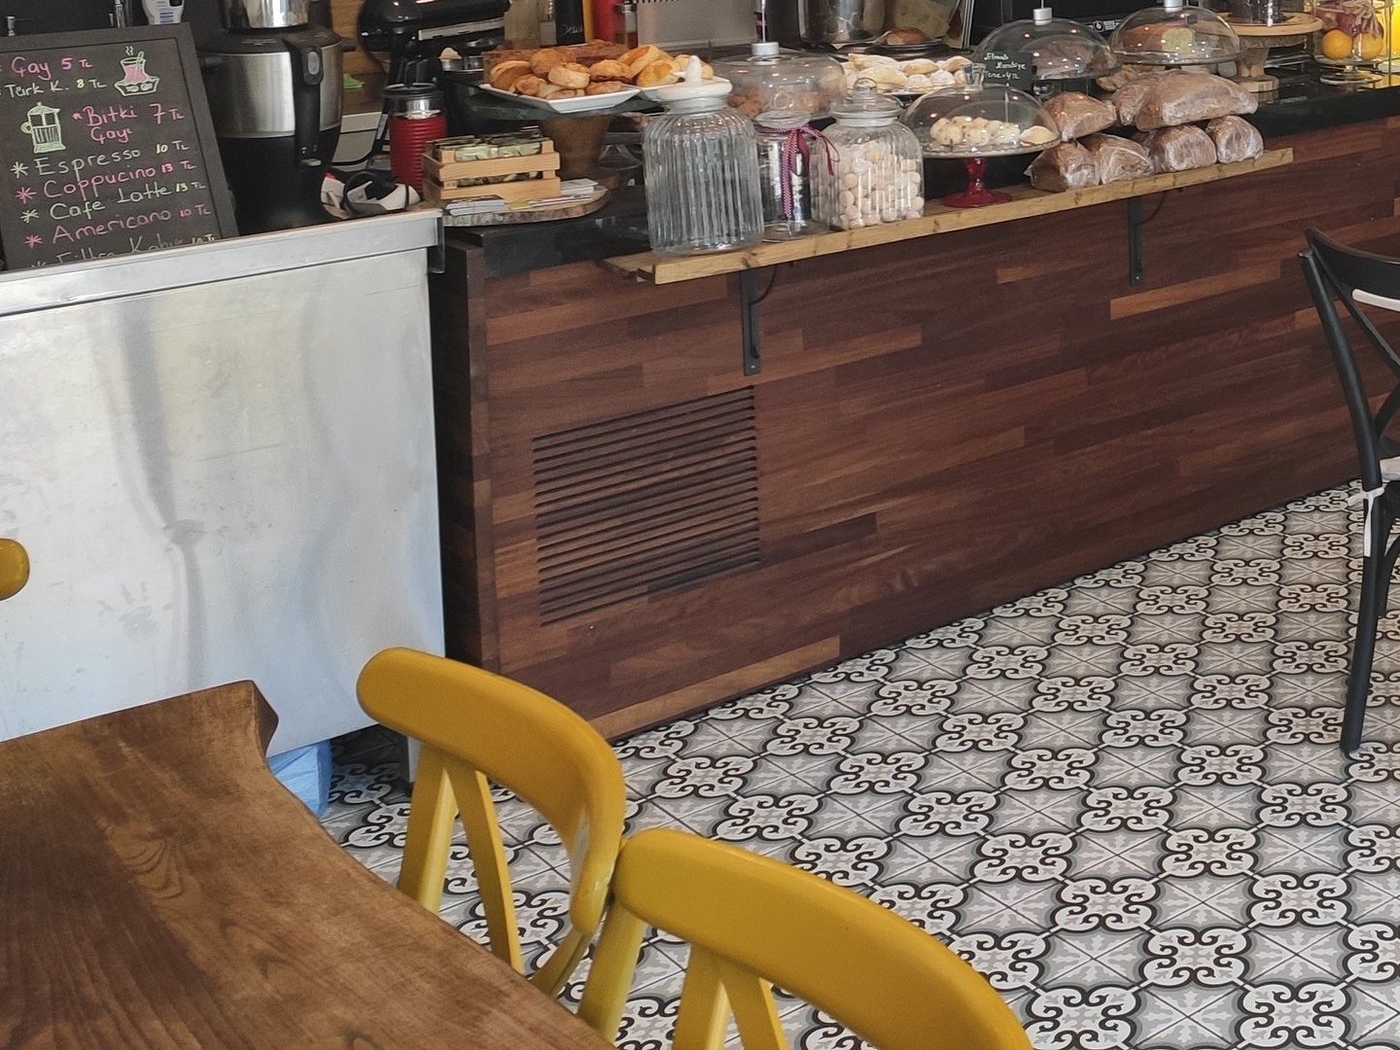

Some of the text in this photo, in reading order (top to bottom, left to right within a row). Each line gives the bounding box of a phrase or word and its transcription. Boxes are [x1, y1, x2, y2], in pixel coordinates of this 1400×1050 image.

[11, 56, 93, 81] Çay 5 TL
[4, 82, 44, 98] Türk
[76, 78, 85, 89] 8
[88, 79, 107, 88] TL
[82, 103, 185, 126] Bitki 7 TL
[34, 140, 190, 182] Espresso 10 TL
[161, 163, 174, 173] 13
[180, 160, 197, 170] TL
[50, 181, 207, 220] Cafe Latte 13 TL
[52, 204, 211, 244] Americano 10 TL
